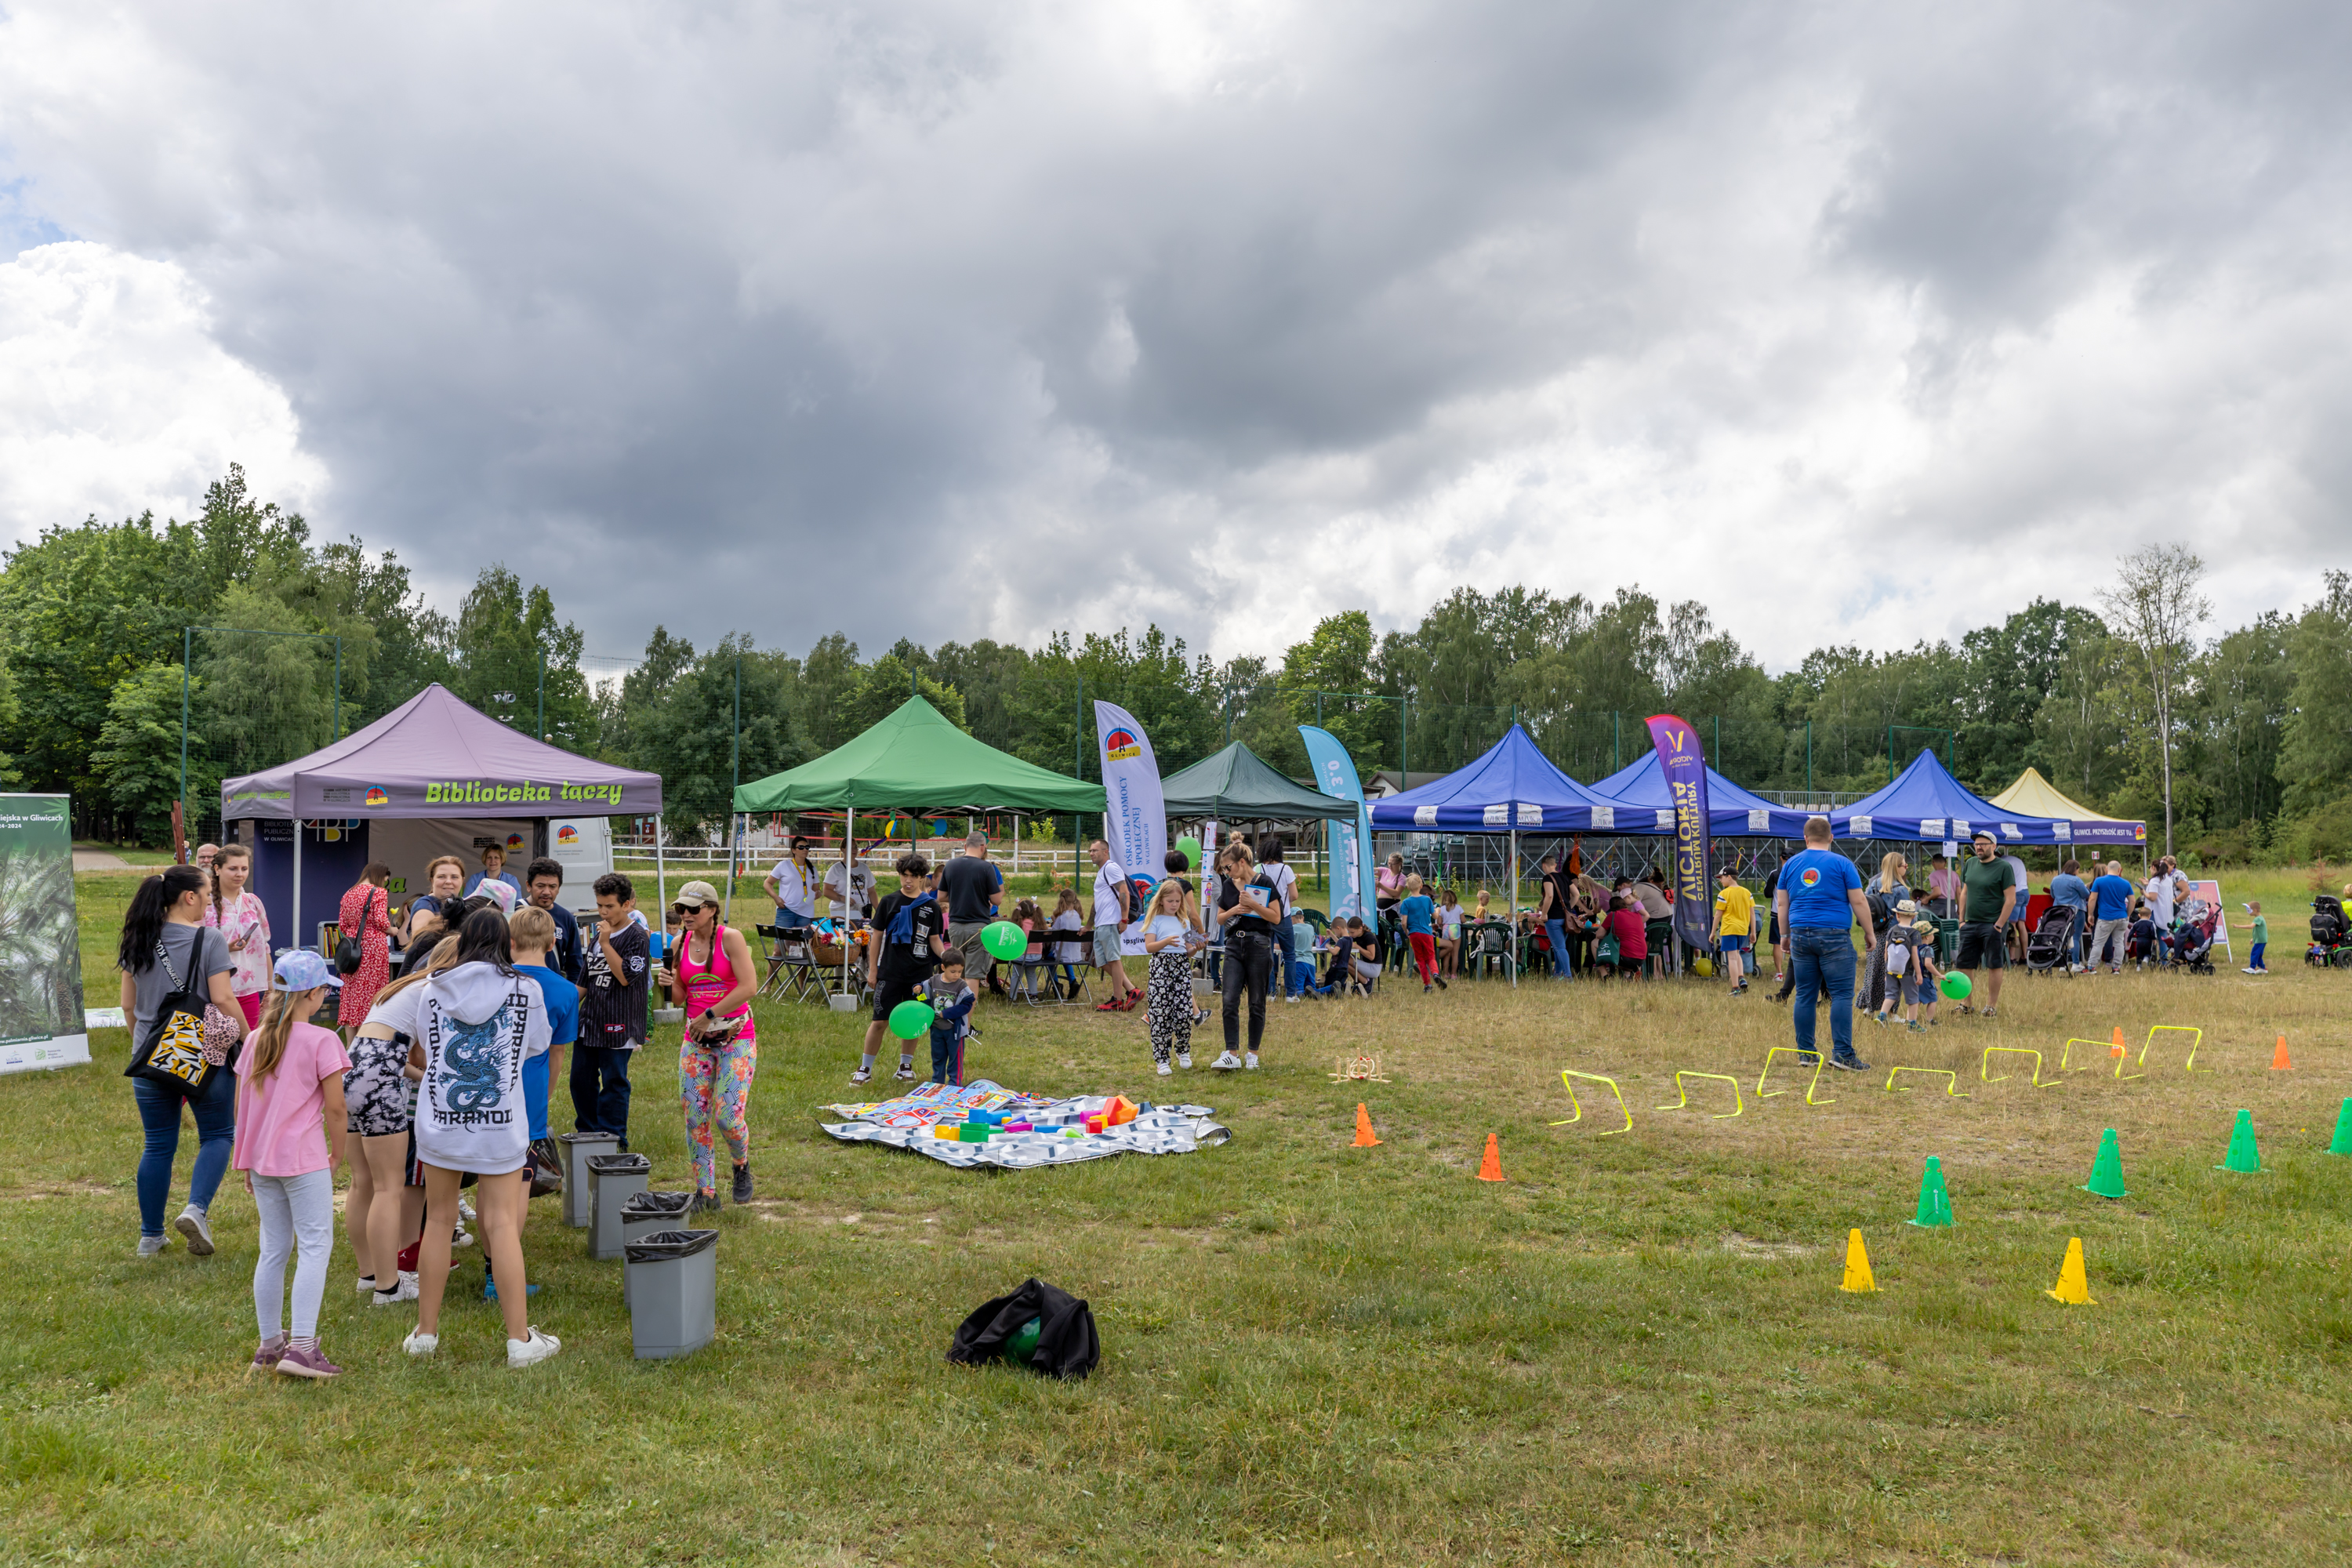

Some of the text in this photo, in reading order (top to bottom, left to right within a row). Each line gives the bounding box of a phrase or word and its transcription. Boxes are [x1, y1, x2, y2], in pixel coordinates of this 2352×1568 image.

[425, 780, 623, 806] Biblioteka łączy
[0, 814, 21, 823] iejska
[1119, 776, 1133, 866] OŚRODEK POMOCY
[1132, 808, 1143, 866] SPOŁECZNEJ
[2092, 827, 2117, 836] PRZYSZŁOŚĆ
[595, 975, 612, 988] 05
